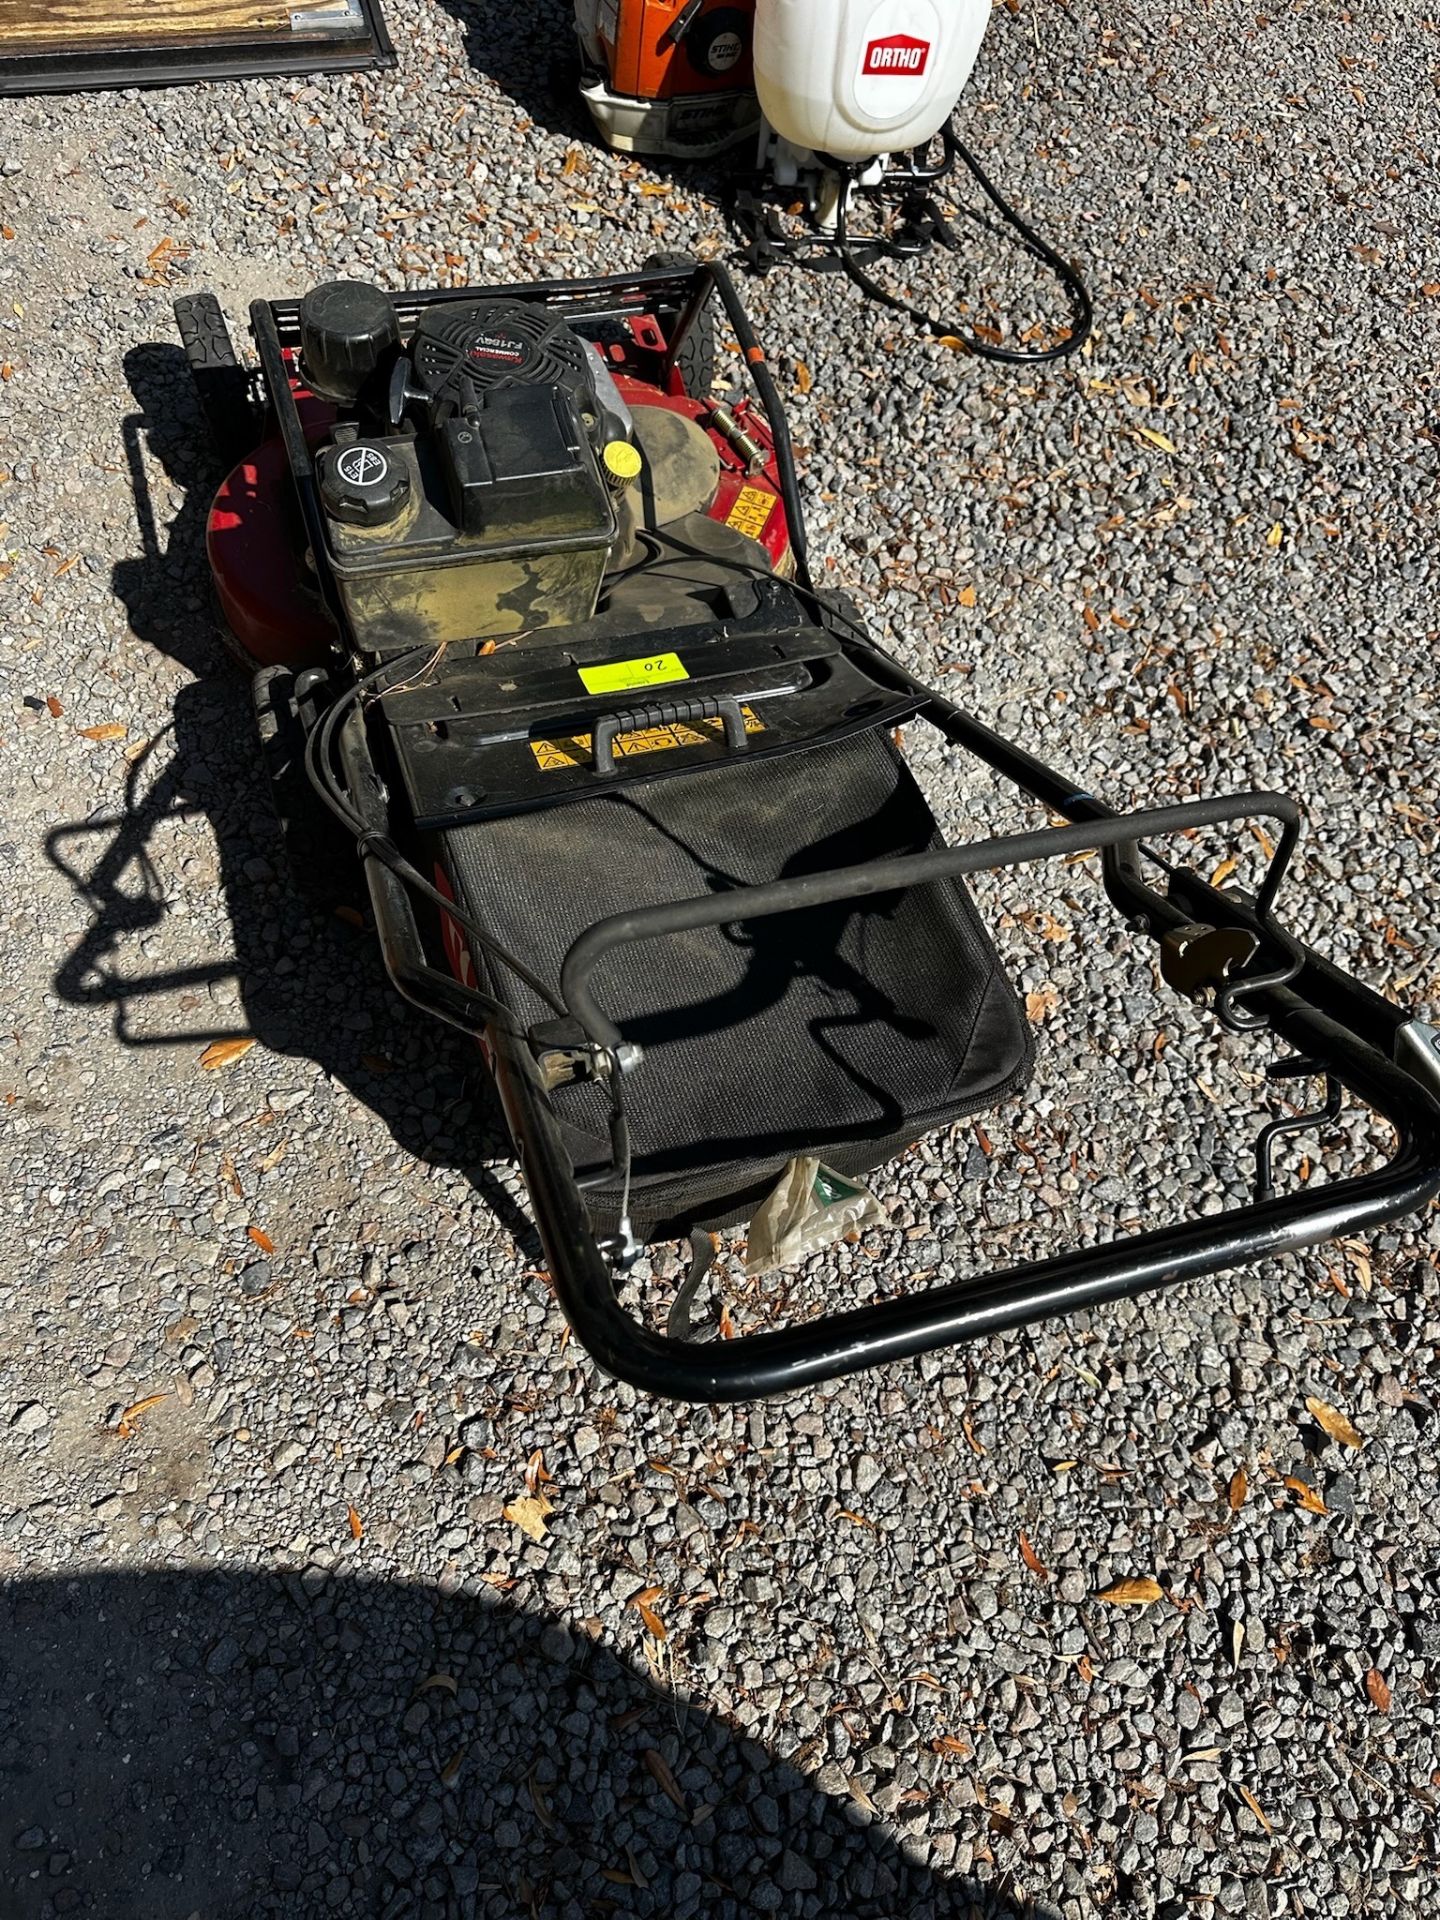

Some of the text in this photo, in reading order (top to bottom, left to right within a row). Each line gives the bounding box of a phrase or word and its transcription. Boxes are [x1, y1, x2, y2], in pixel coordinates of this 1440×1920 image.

[869, 46, 922, 69] ORTHO
[475, 346, 520, 357] COMMERCIAL
[366, 452, 382, 466] E85
[343, 465, 359, 479] E15
[644, 660, 668, 672] 20
